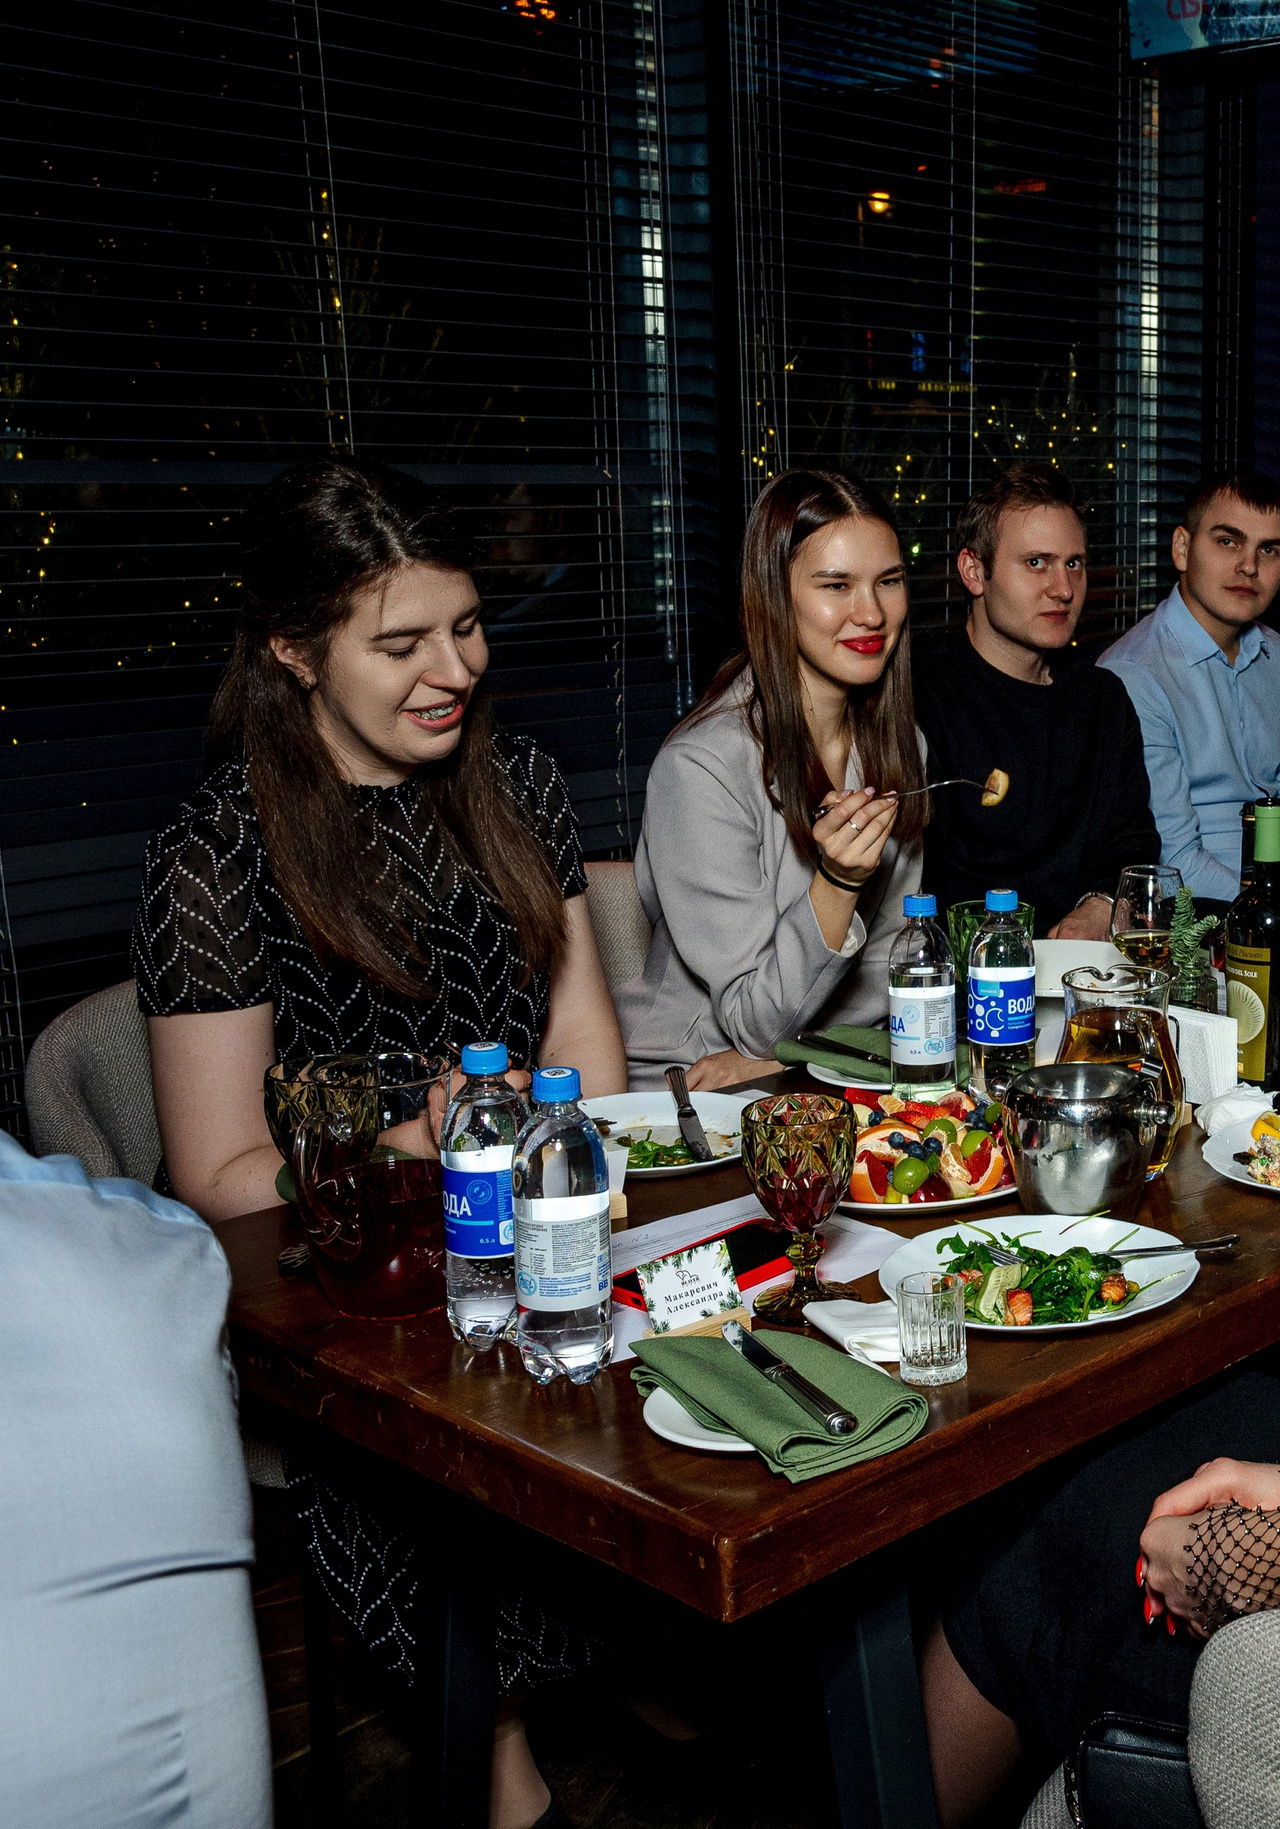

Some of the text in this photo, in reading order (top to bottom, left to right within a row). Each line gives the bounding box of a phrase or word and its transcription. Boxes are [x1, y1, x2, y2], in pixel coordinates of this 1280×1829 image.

[442, 1190, 472, 1218] ОДА
[664, 1281, 718, 1304] Макаревич
[667, 1290, 723, 1315] Александра
